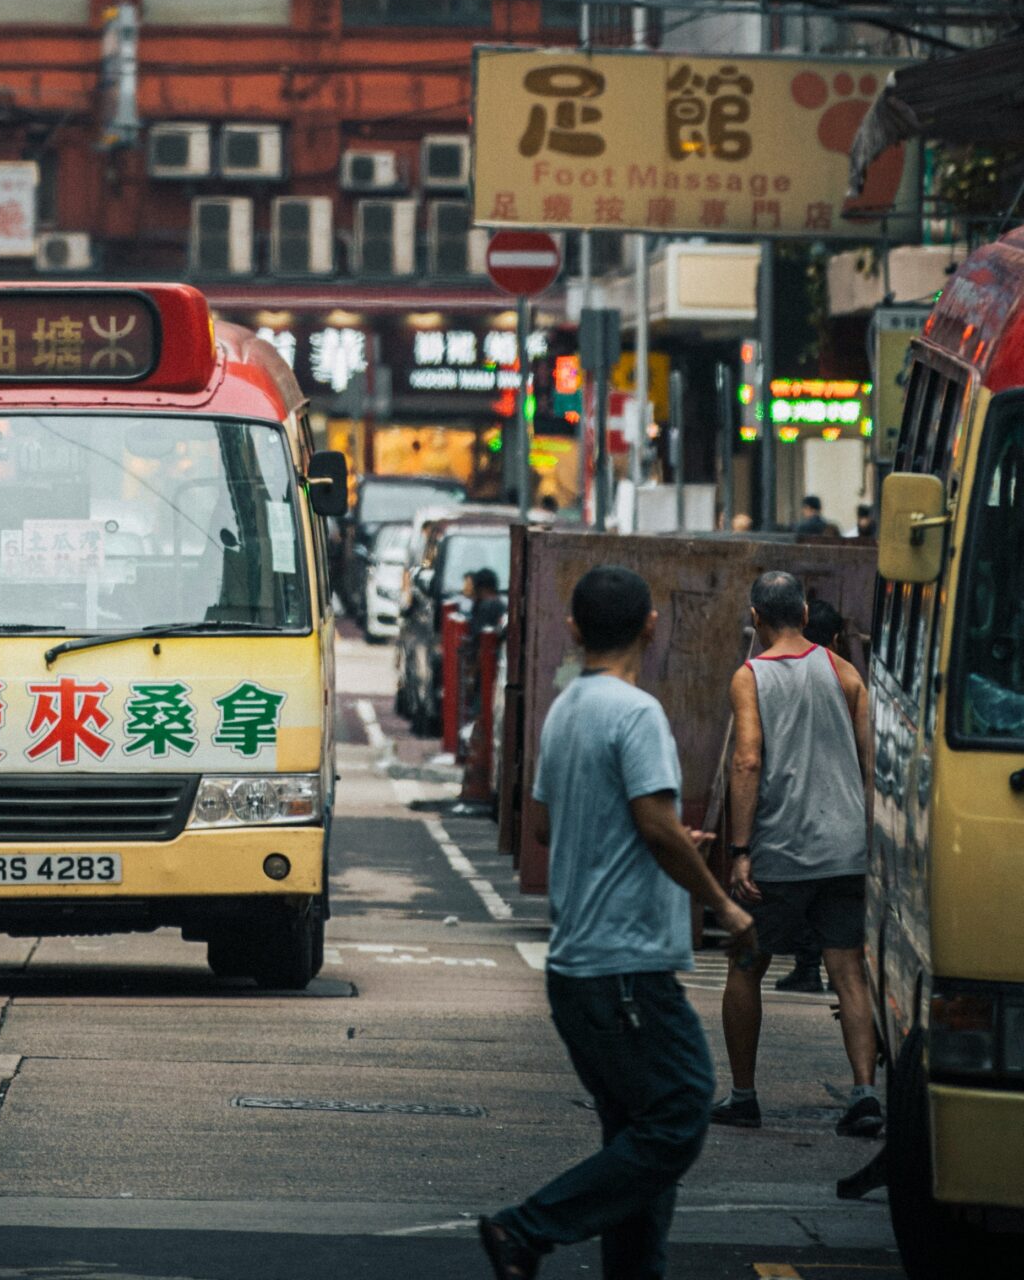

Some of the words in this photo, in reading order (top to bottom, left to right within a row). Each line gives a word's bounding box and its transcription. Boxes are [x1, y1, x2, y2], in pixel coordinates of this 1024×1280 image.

[532, 160, 616, 190] Foot
[627, 164, 791, 197] Massage
[38, 856, 115, 880] 4283
